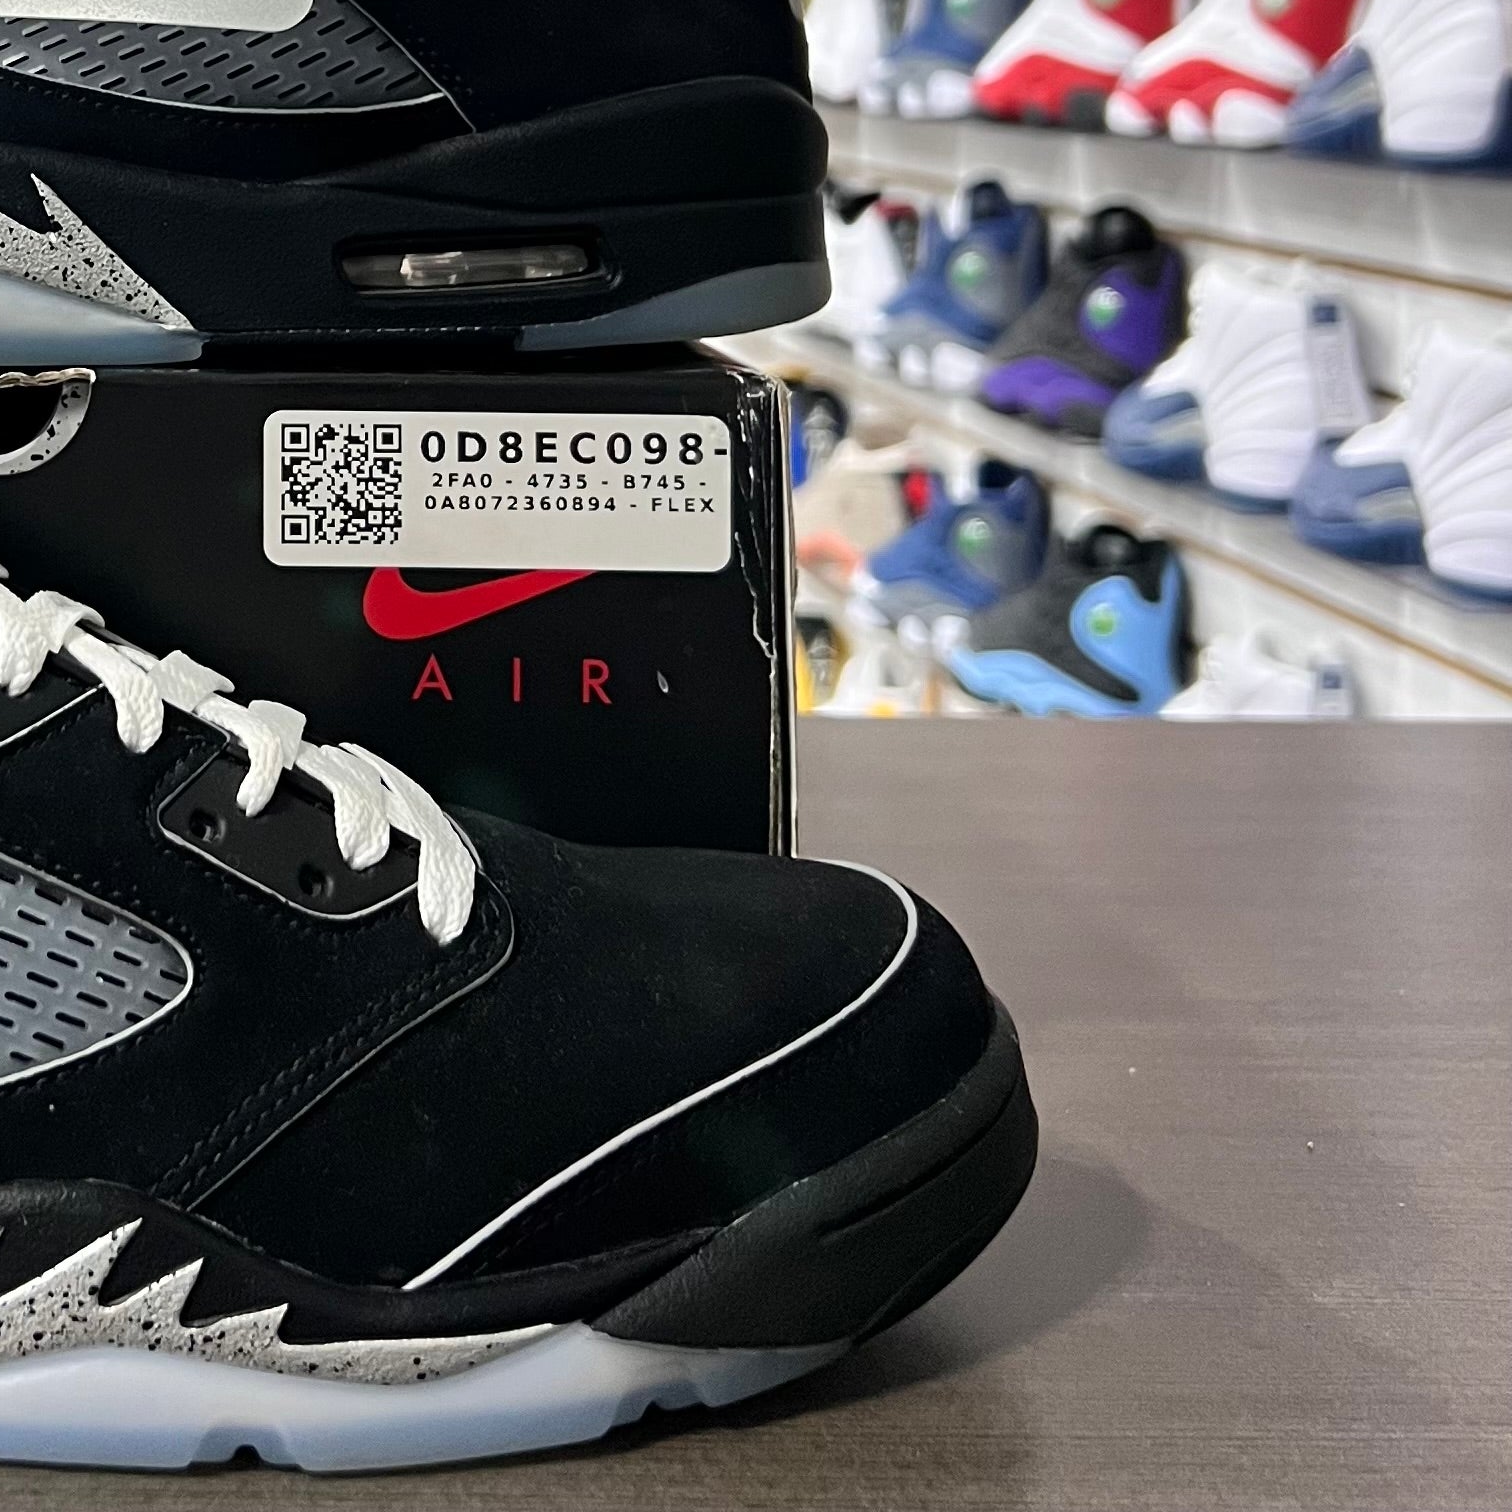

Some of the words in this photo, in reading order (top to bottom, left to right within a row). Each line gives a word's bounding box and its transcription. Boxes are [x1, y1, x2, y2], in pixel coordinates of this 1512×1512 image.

[526, 473, 588, 490] 4735
[651, 497, 715, 513] FLEX
[412, 653, 612, 704] AIR
